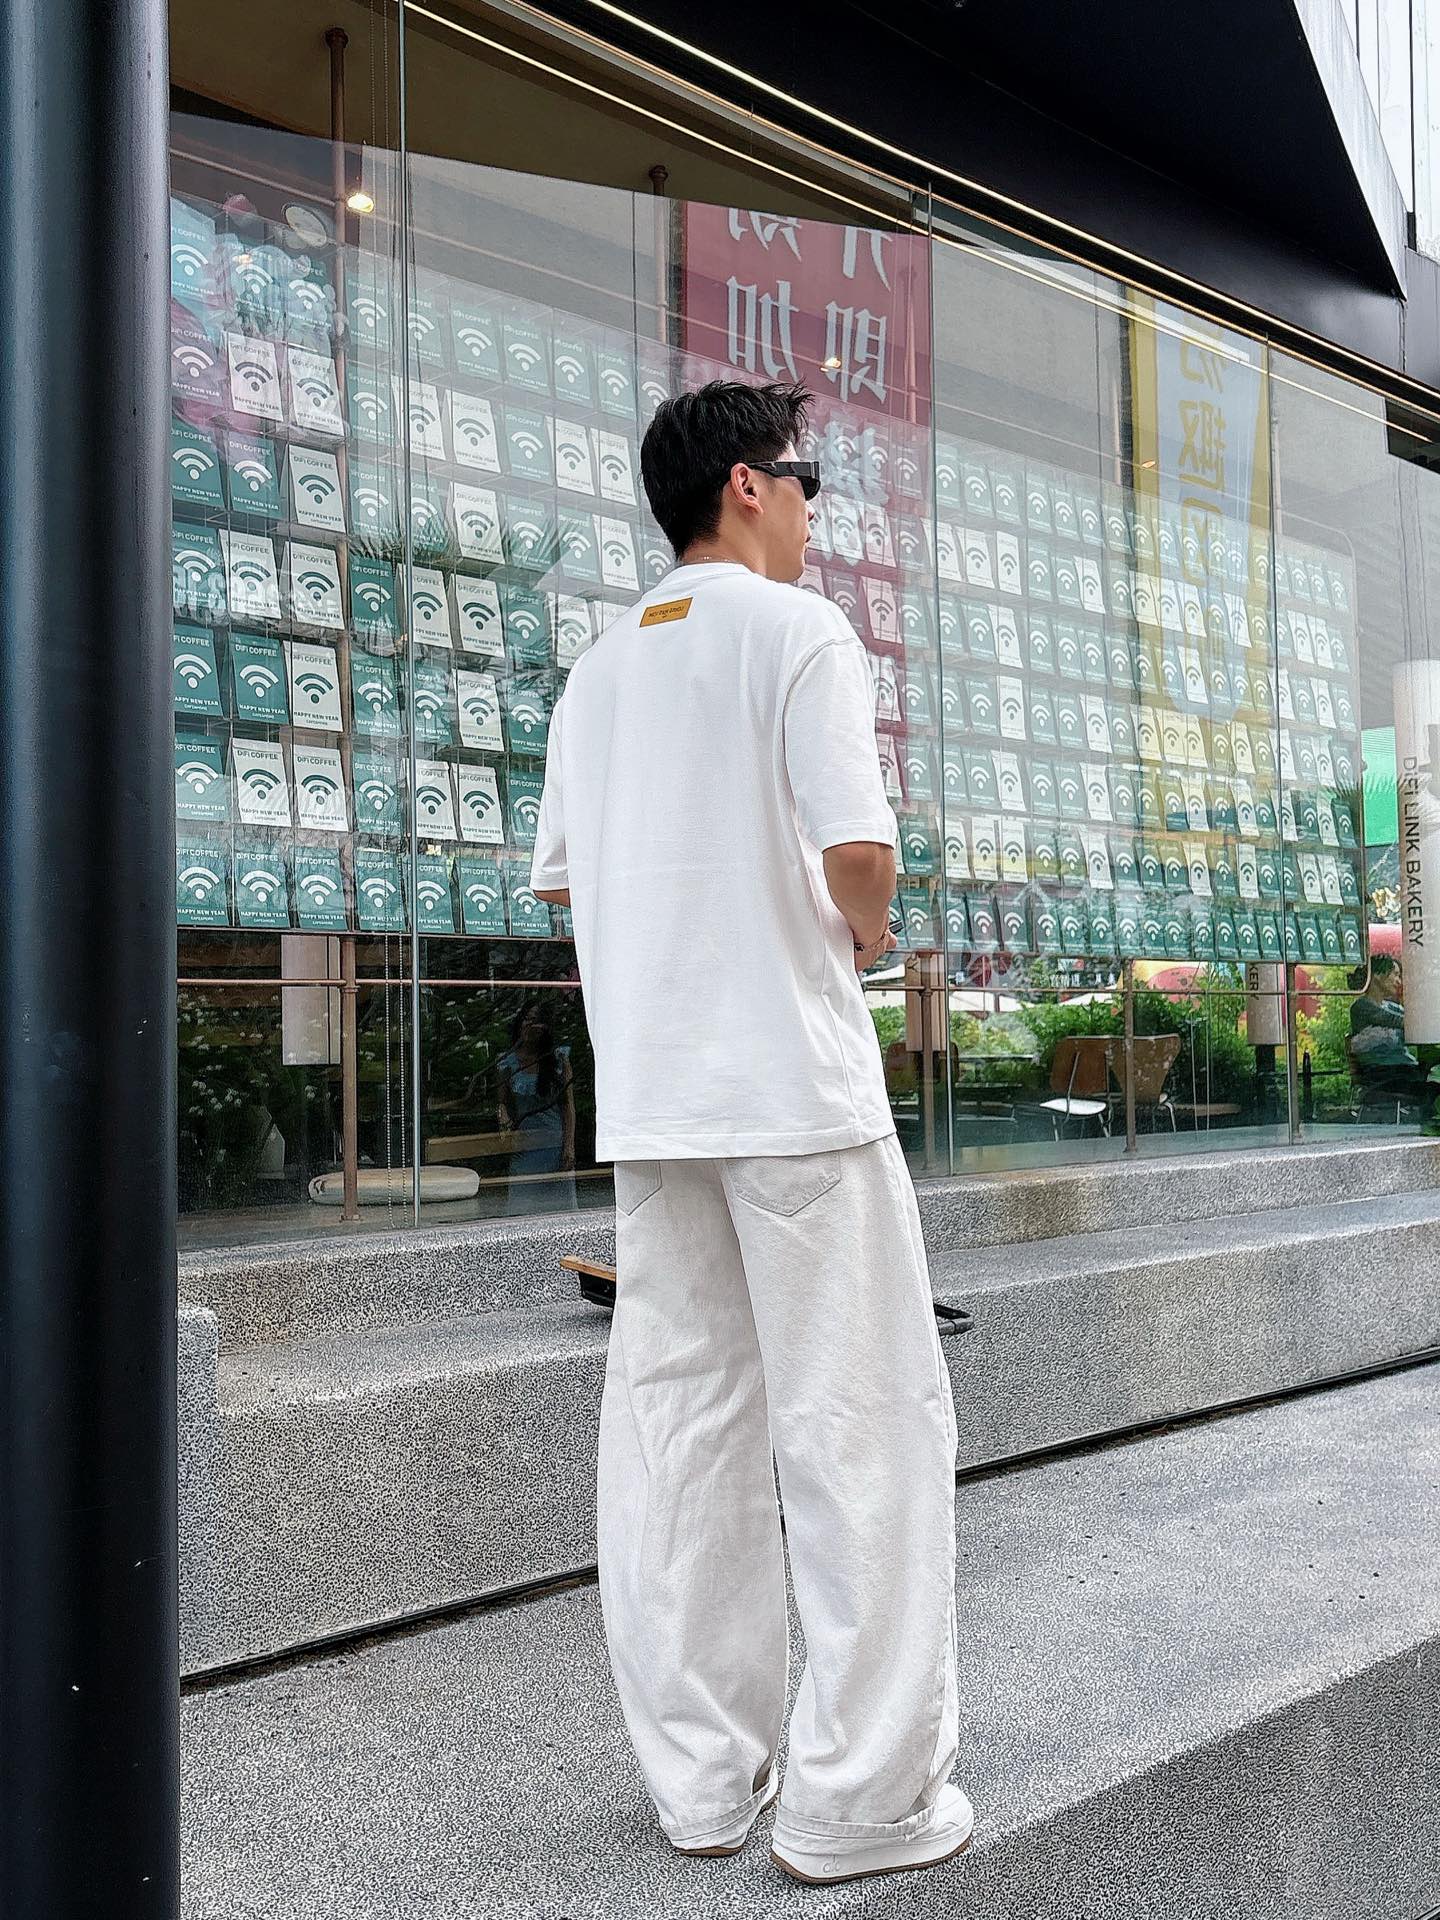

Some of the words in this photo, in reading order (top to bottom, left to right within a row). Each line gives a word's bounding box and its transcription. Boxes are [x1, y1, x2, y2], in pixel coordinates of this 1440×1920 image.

[184, 432, 212, 443] COFFEE
[307, 459, 333, 470] COFFEE
[185, 534, 214, 544] COFFEE
[241, 544, 269, 554] COFFEE
[363, 567, 389, 577] COFFEE
[181, 636, 209, 647] COFFEE
[249, 646, 277, 656] COFFEE
[305, 656, 332, 665] COFFEE
[187, 745, 215, 754] COFFEE
[251, 752, 278, 760] COFFEE
[311, 758, 336, 766] COFFEE
[1404, 803, 1421, 853] LINK
[1406, 860, 1425, 947] BAKERY
